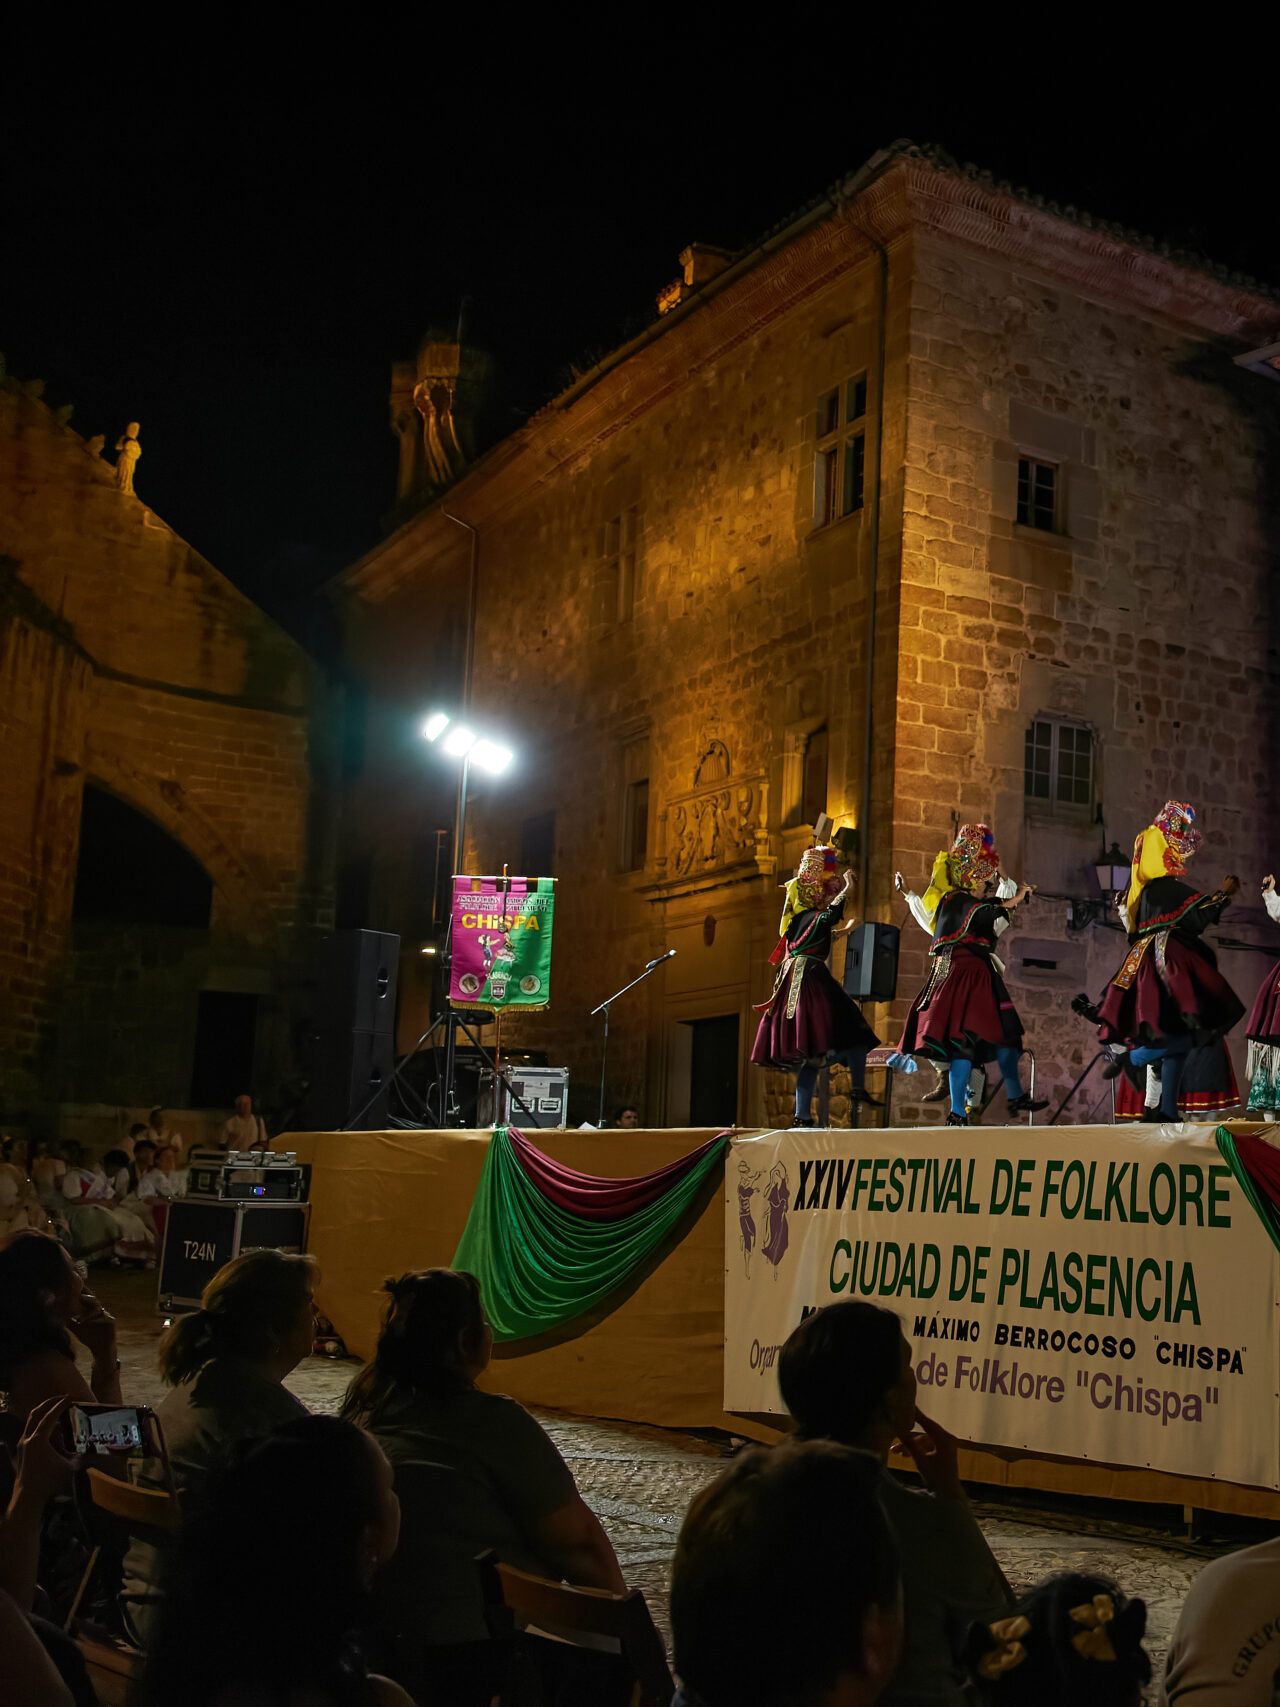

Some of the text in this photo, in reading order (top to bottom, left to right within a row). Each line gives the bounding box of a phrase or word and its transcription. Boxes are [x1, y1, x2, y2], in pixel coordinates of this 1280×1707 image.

[851, 1157, 981, 1214] FESTIVAL
[989, 1158, 1036, 1217] DE
[1040, 1159, 1233, 1229] FOLKLORE
[183, 1240, 216, 1262] T24N
[829, 1238, 1202, 1326] CIUDAD DE PLASENCIA
[912, 1310, 981, 1343] MÁXIMO
[994, 1323, 1136, 1360] BERROCOSO
[916, 1352, 948, 1387] de
[954, 1355, 1065, 1403] Folklore
[1076, 1370, 1219, 1427] "Chispa"
